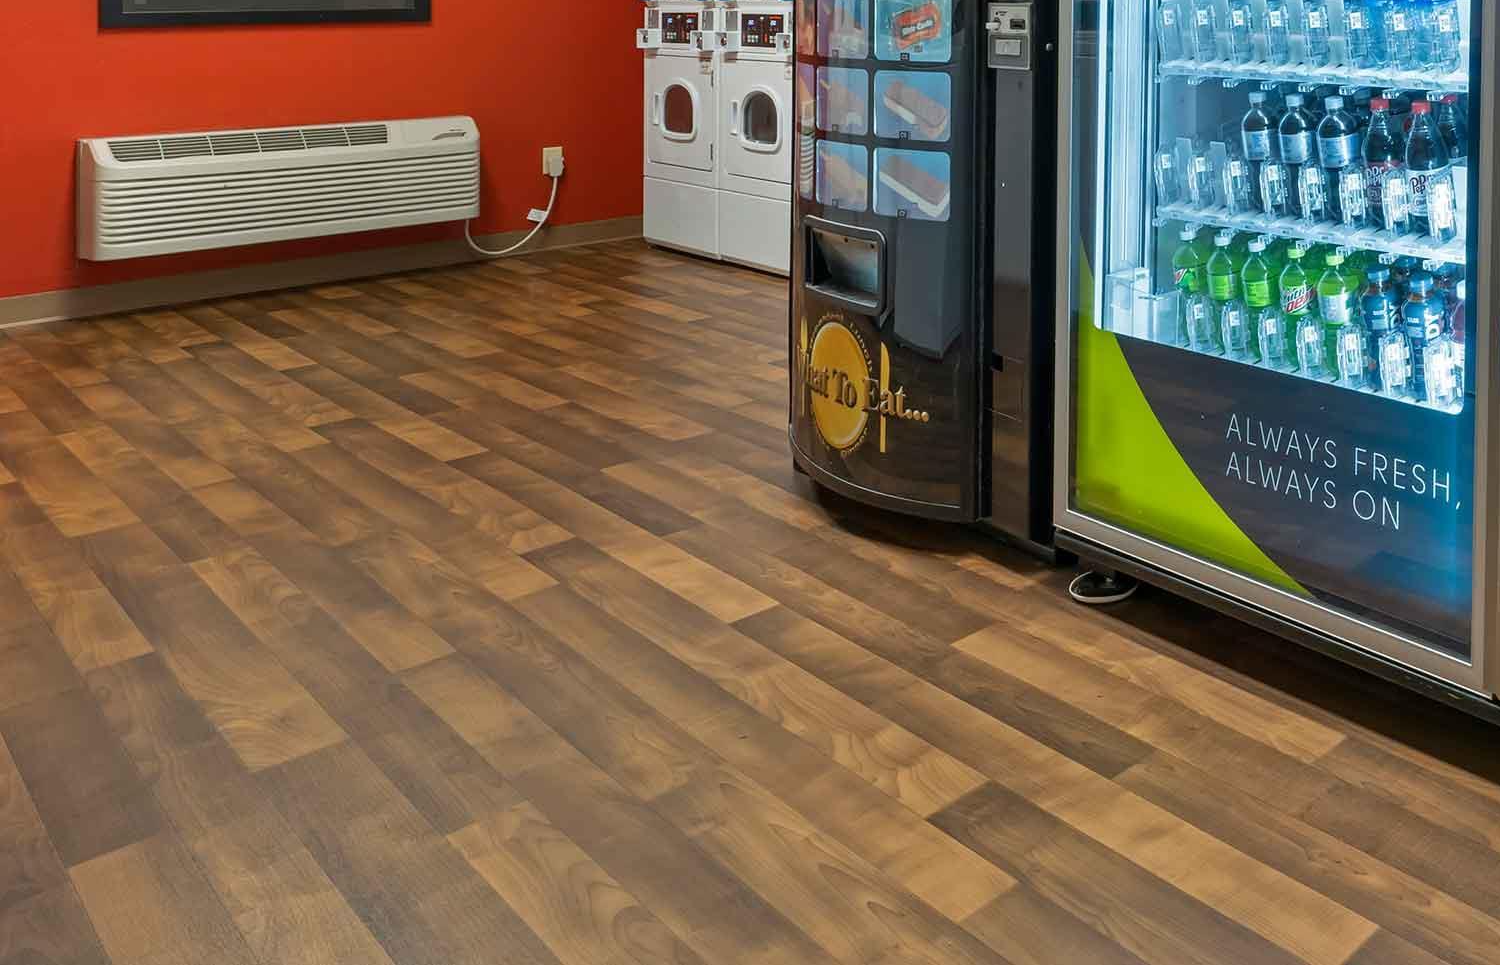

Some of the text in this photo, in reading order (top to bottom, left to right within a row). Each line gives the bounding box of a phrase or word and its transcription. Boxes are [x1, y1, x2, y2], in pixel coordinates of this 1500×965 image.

[831, 369, 858, 408] To
[1225, 413, 1462, 510] ALWAYS FRESH,
[1225, 451, 1400, 530] ALWAYS ON
